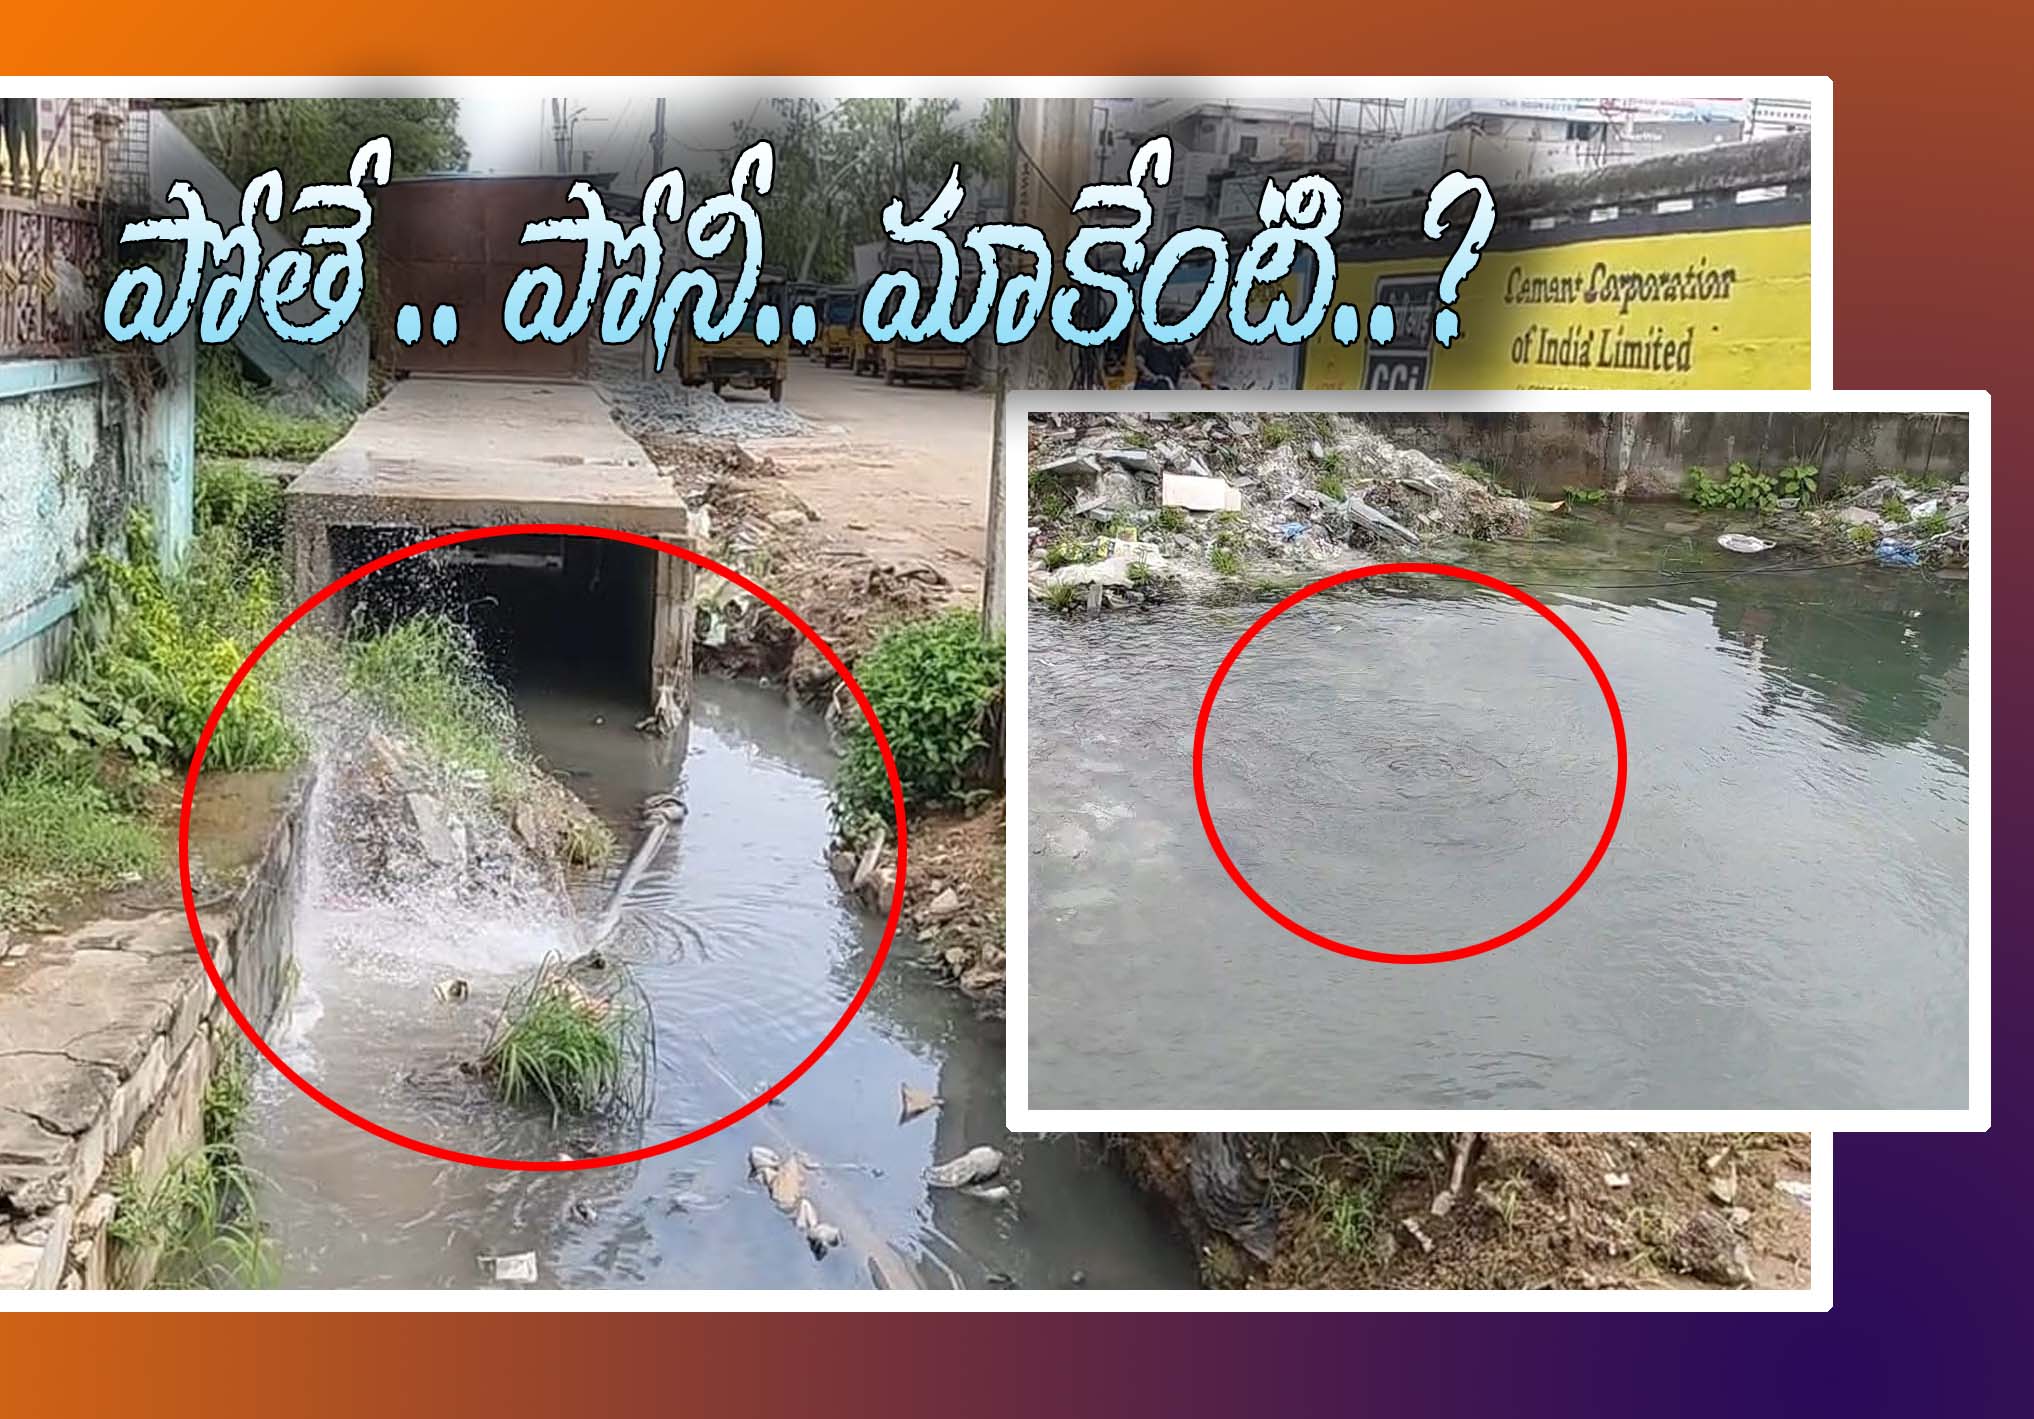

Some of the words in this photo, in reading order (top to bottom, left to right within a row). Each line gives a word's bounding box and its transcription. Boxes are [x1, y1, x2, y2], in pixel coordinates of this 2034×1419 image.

[1504, 265, 1583, 303] Cement
[1584, 256, 1736, 314] Corporation
[1511, 324, 1537, 364] of
[1536, 325, 1593, 367] India
[1596, 325, 1695, 372] Limited
